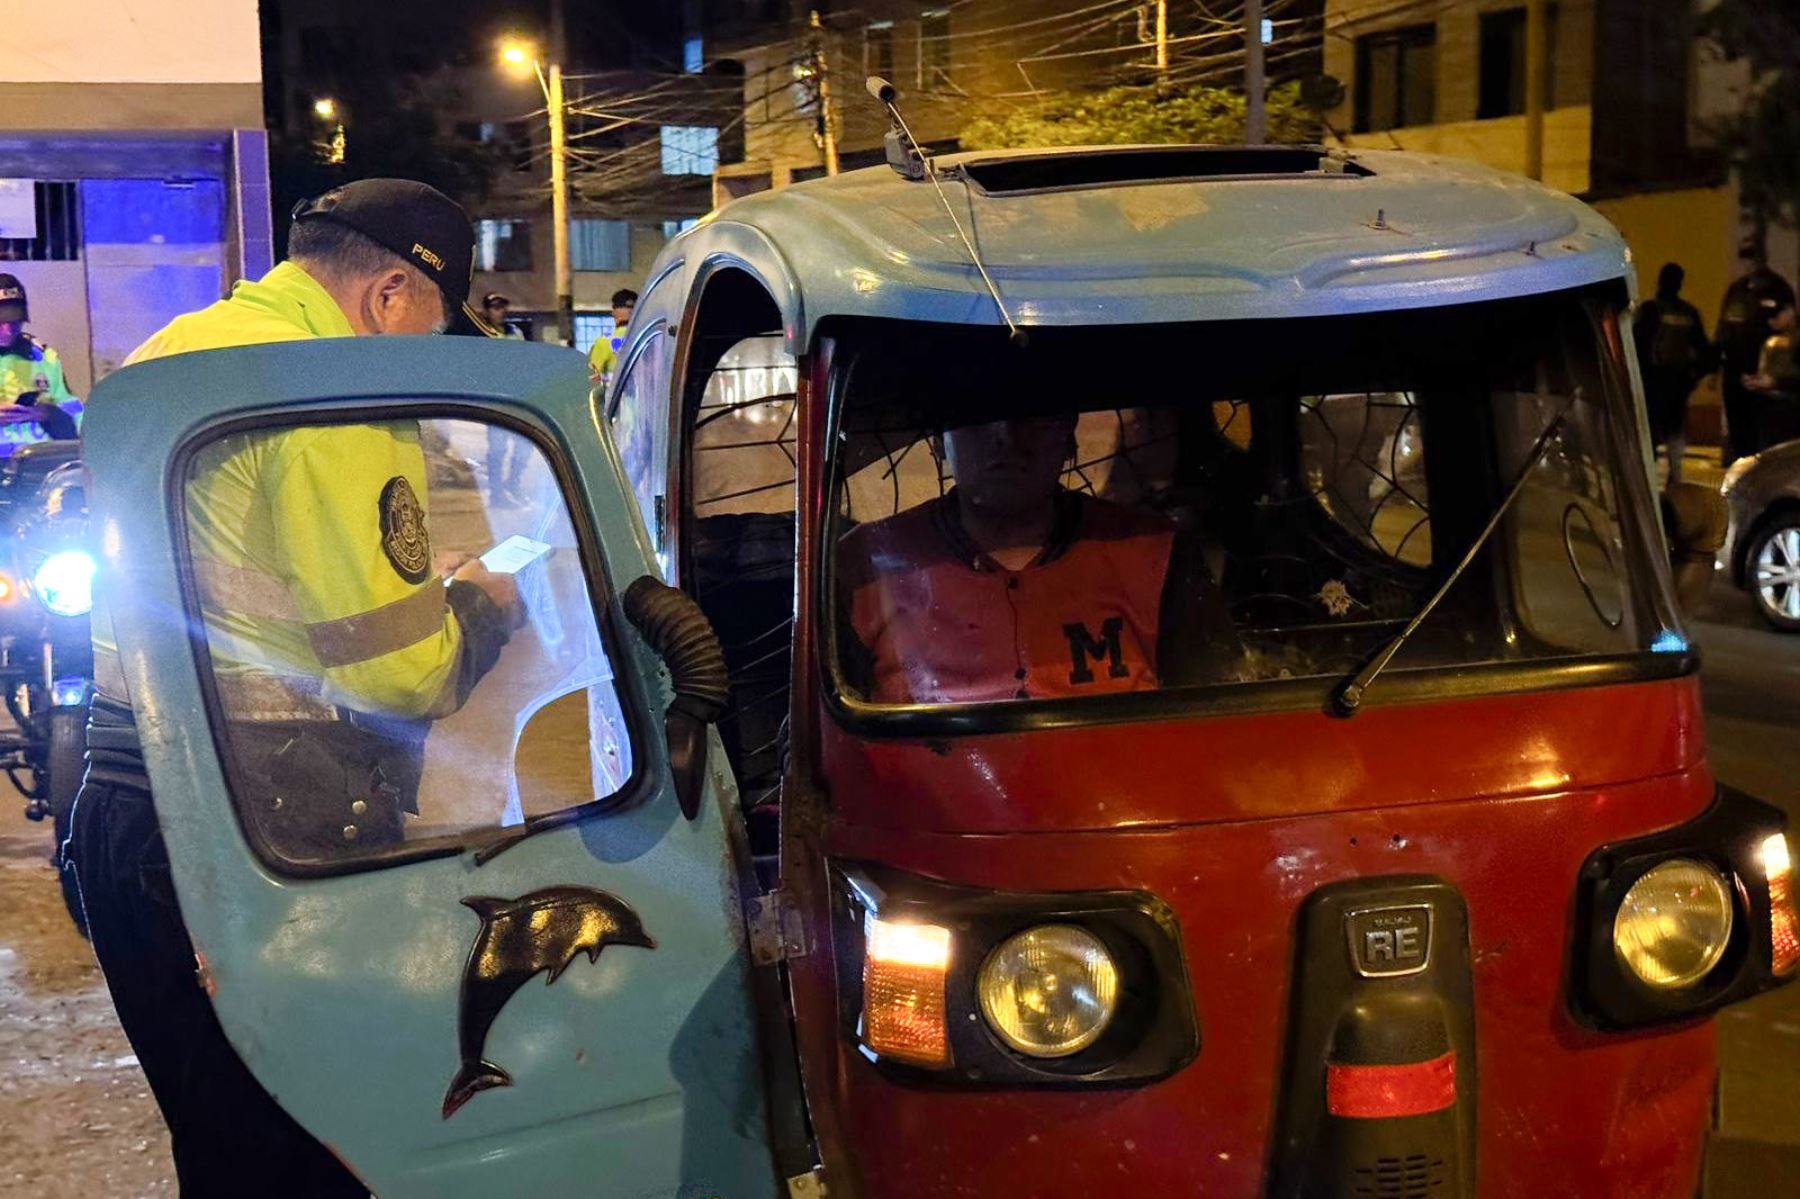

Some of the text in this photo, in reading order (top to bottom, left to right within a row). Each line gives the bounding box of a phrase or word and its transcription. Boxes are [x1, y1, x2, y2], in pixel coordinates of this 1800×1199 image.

[412, 243, 446, 271] PERU
[1062, 617, 1130, 685] M
[1365, 927, 1418, 962] RE
